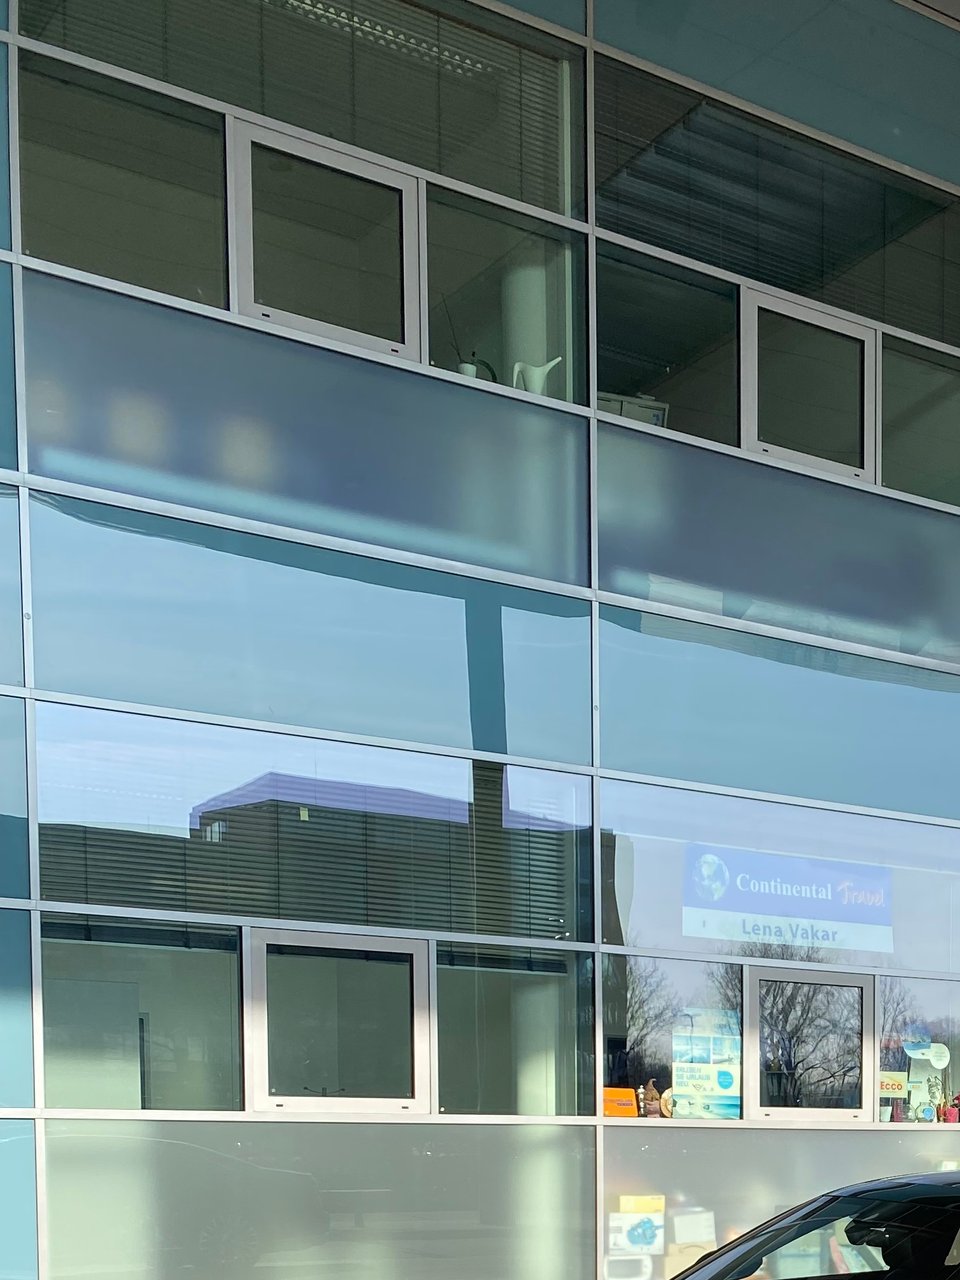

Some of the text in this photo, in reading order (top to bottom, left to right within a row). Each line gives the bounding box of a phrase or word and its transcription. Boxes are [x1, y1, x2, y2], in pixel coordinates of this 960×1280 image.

[736, 873, 886, 907] Continental Travel
[742, 919, 838, 942] Lena Vakar
